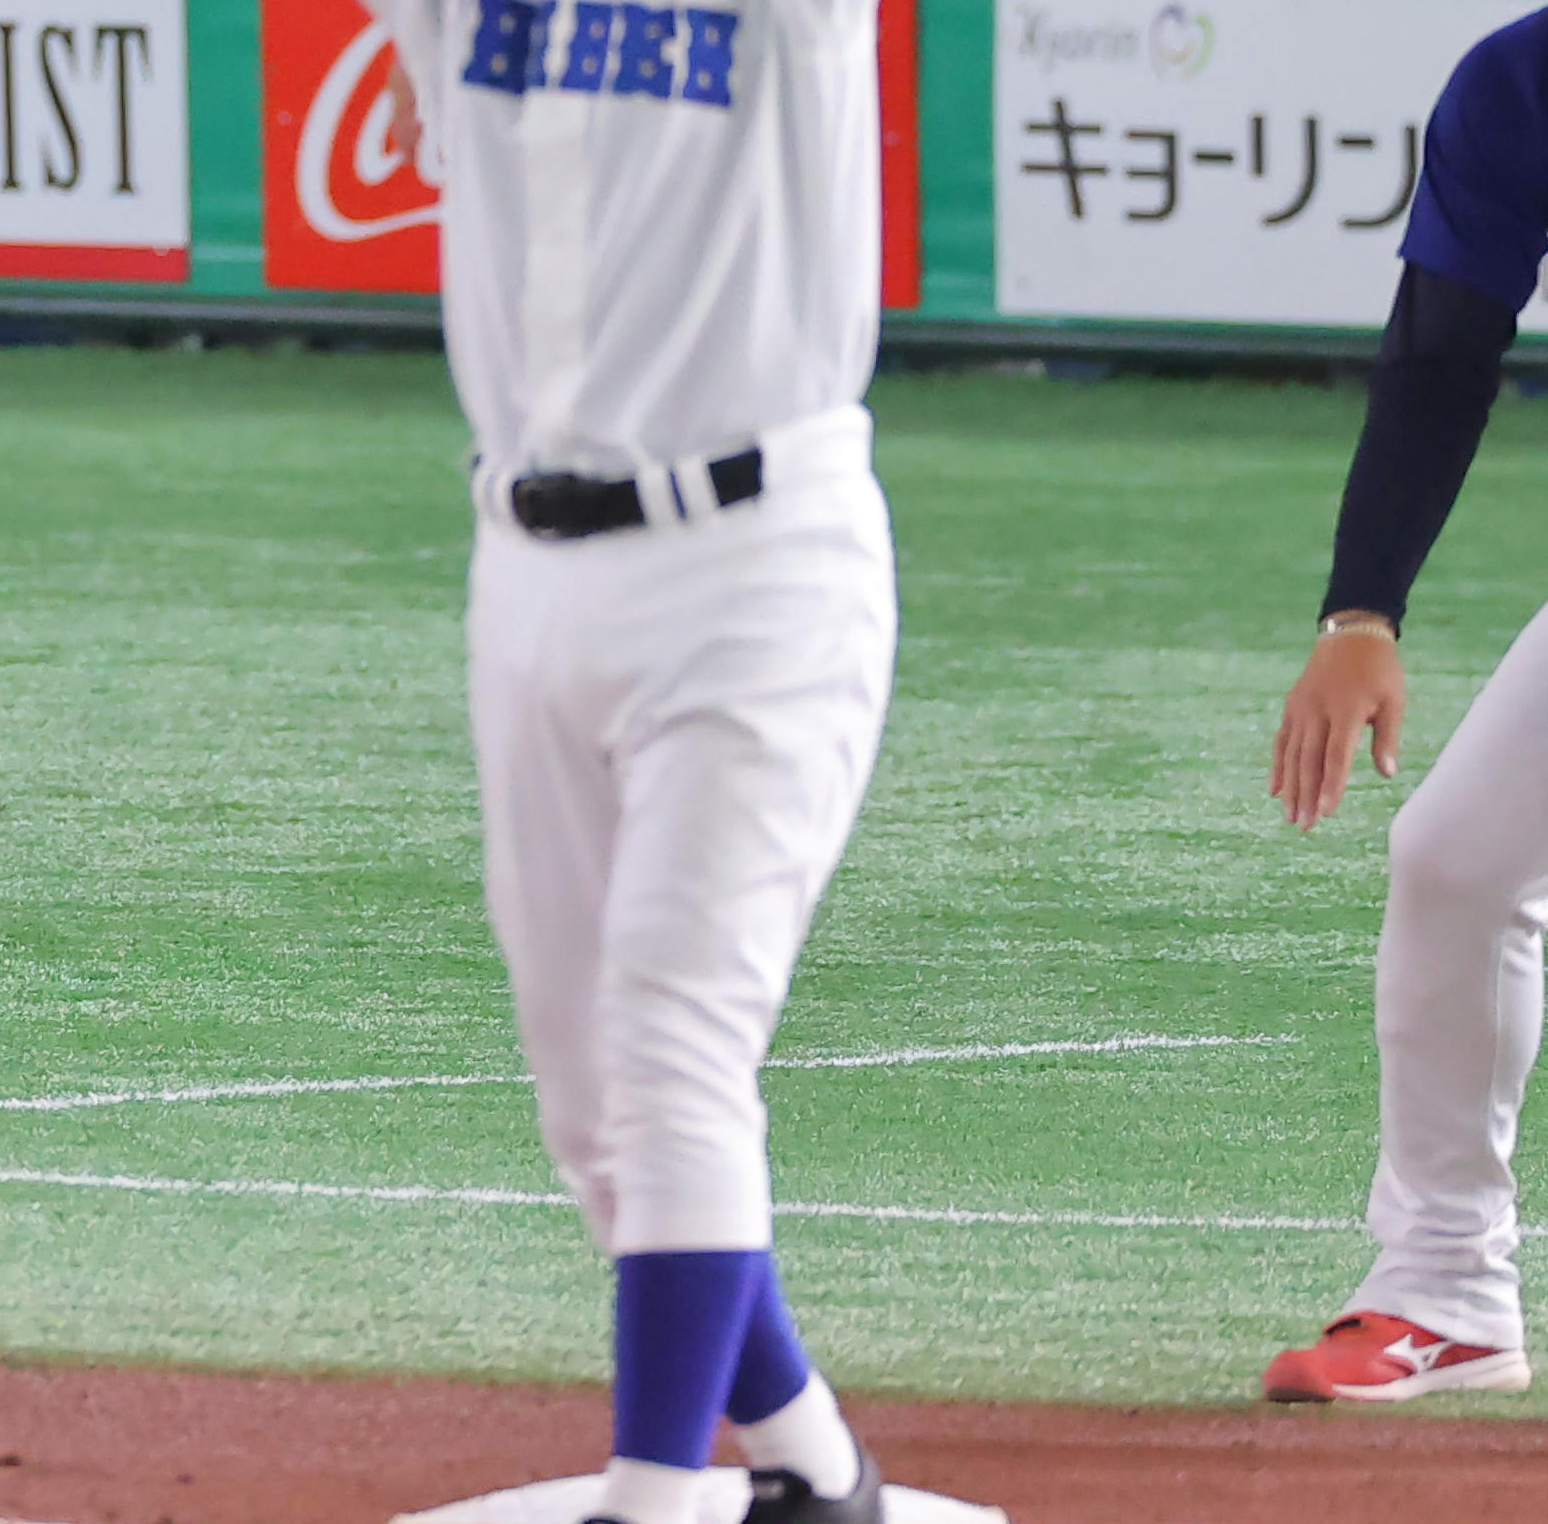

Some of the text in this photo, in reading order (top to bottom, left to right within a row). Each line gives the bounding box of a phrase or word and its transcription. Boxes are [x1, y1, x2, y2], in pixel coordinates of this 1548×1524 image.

[1019, 96, 1426, 229] キョーリン
